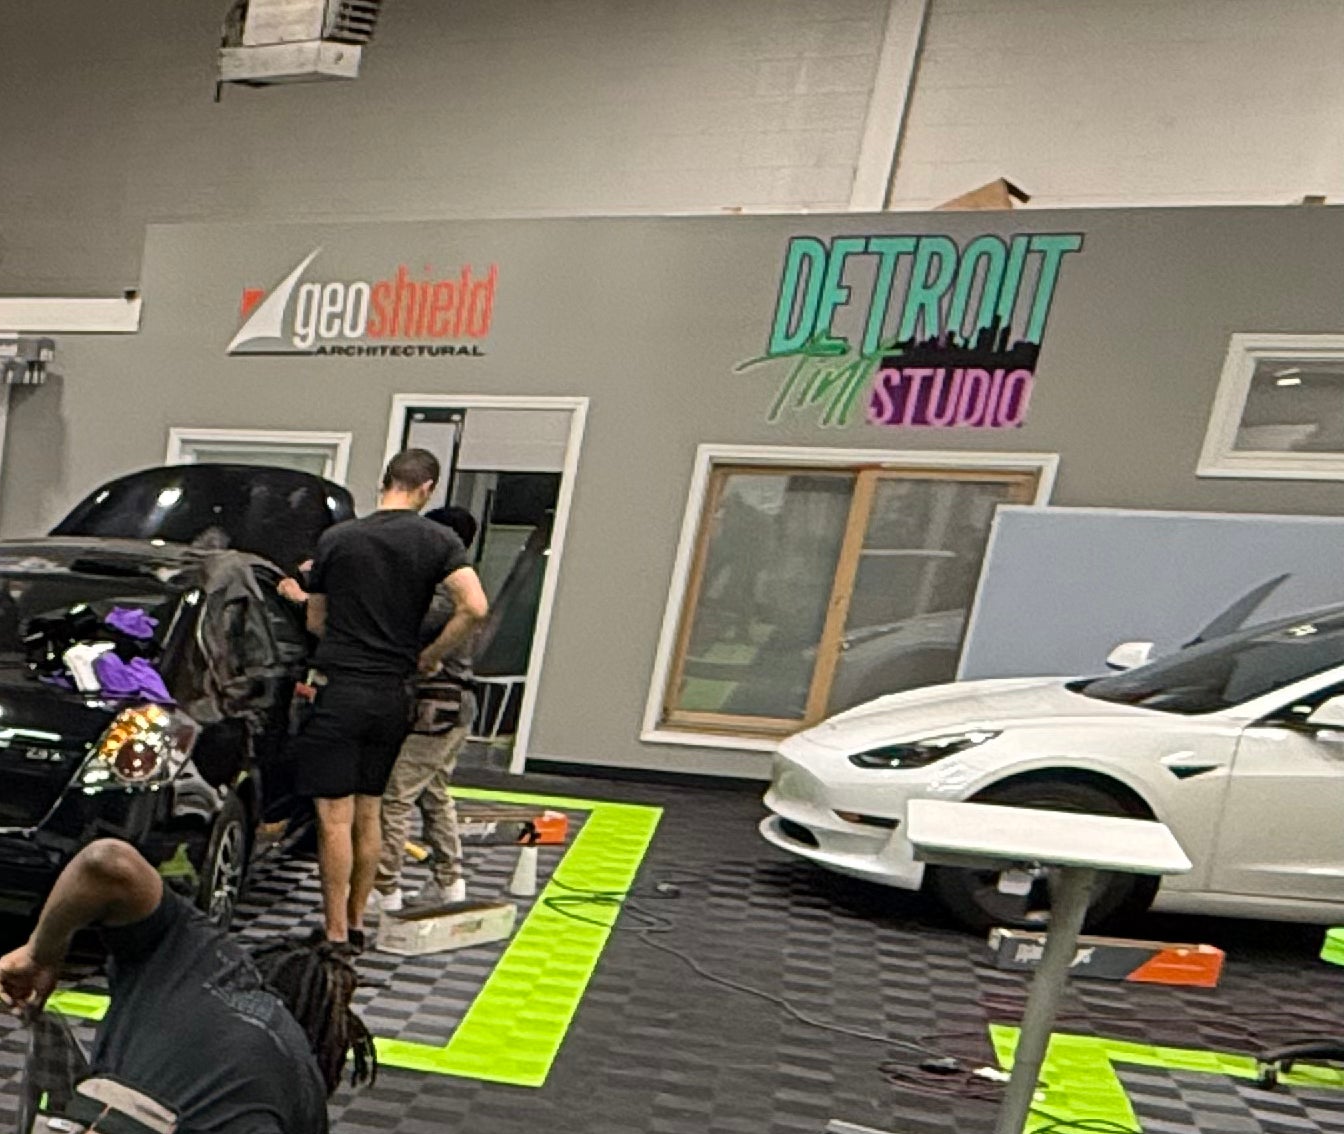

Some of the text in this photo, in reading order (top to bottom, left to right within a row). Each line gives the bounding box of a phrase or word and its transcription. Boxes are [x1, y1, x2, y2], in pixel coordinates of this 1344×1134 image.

[291, 263, 499, 349] geoshield
[767, 232, 1086, 356] DETROIT
[314, 345, 488, 357] ARCHITECTURAL
[732, 328, 1037, 428] Tint STUDIO
